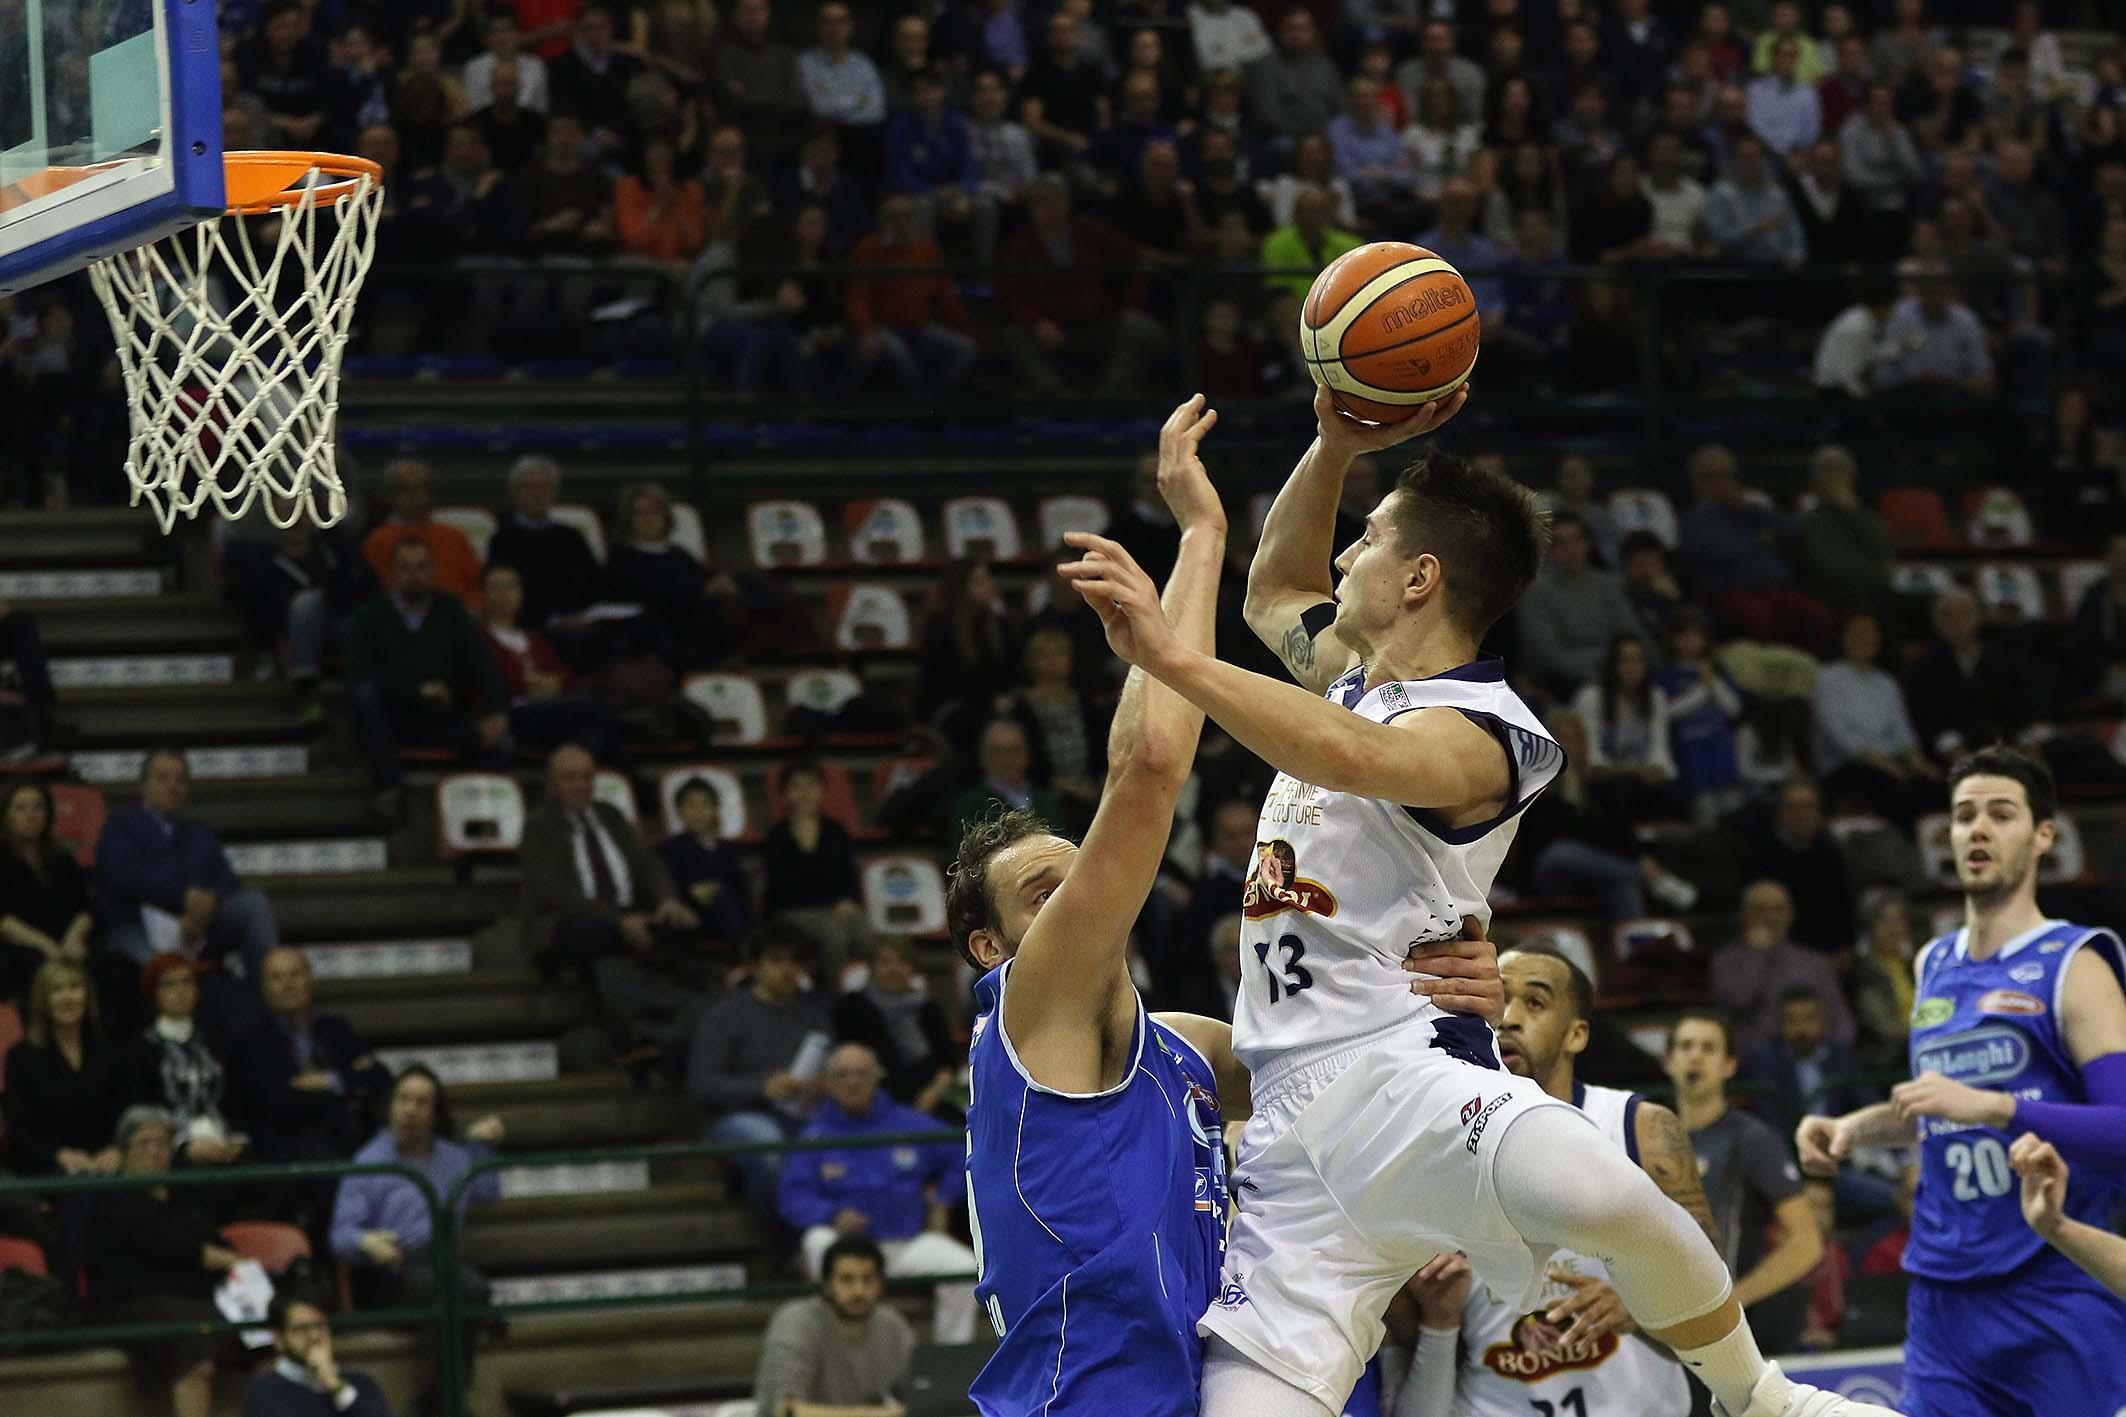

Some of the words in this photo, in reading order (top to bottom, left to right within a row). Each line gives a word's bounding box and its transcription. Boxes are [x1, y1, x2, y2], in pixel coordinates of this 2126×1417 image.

[1380, 284, 1467, 337] molten
[1253, 935, 1314, 1005] 13
[1945, 1137, 2012, 1201] 20
